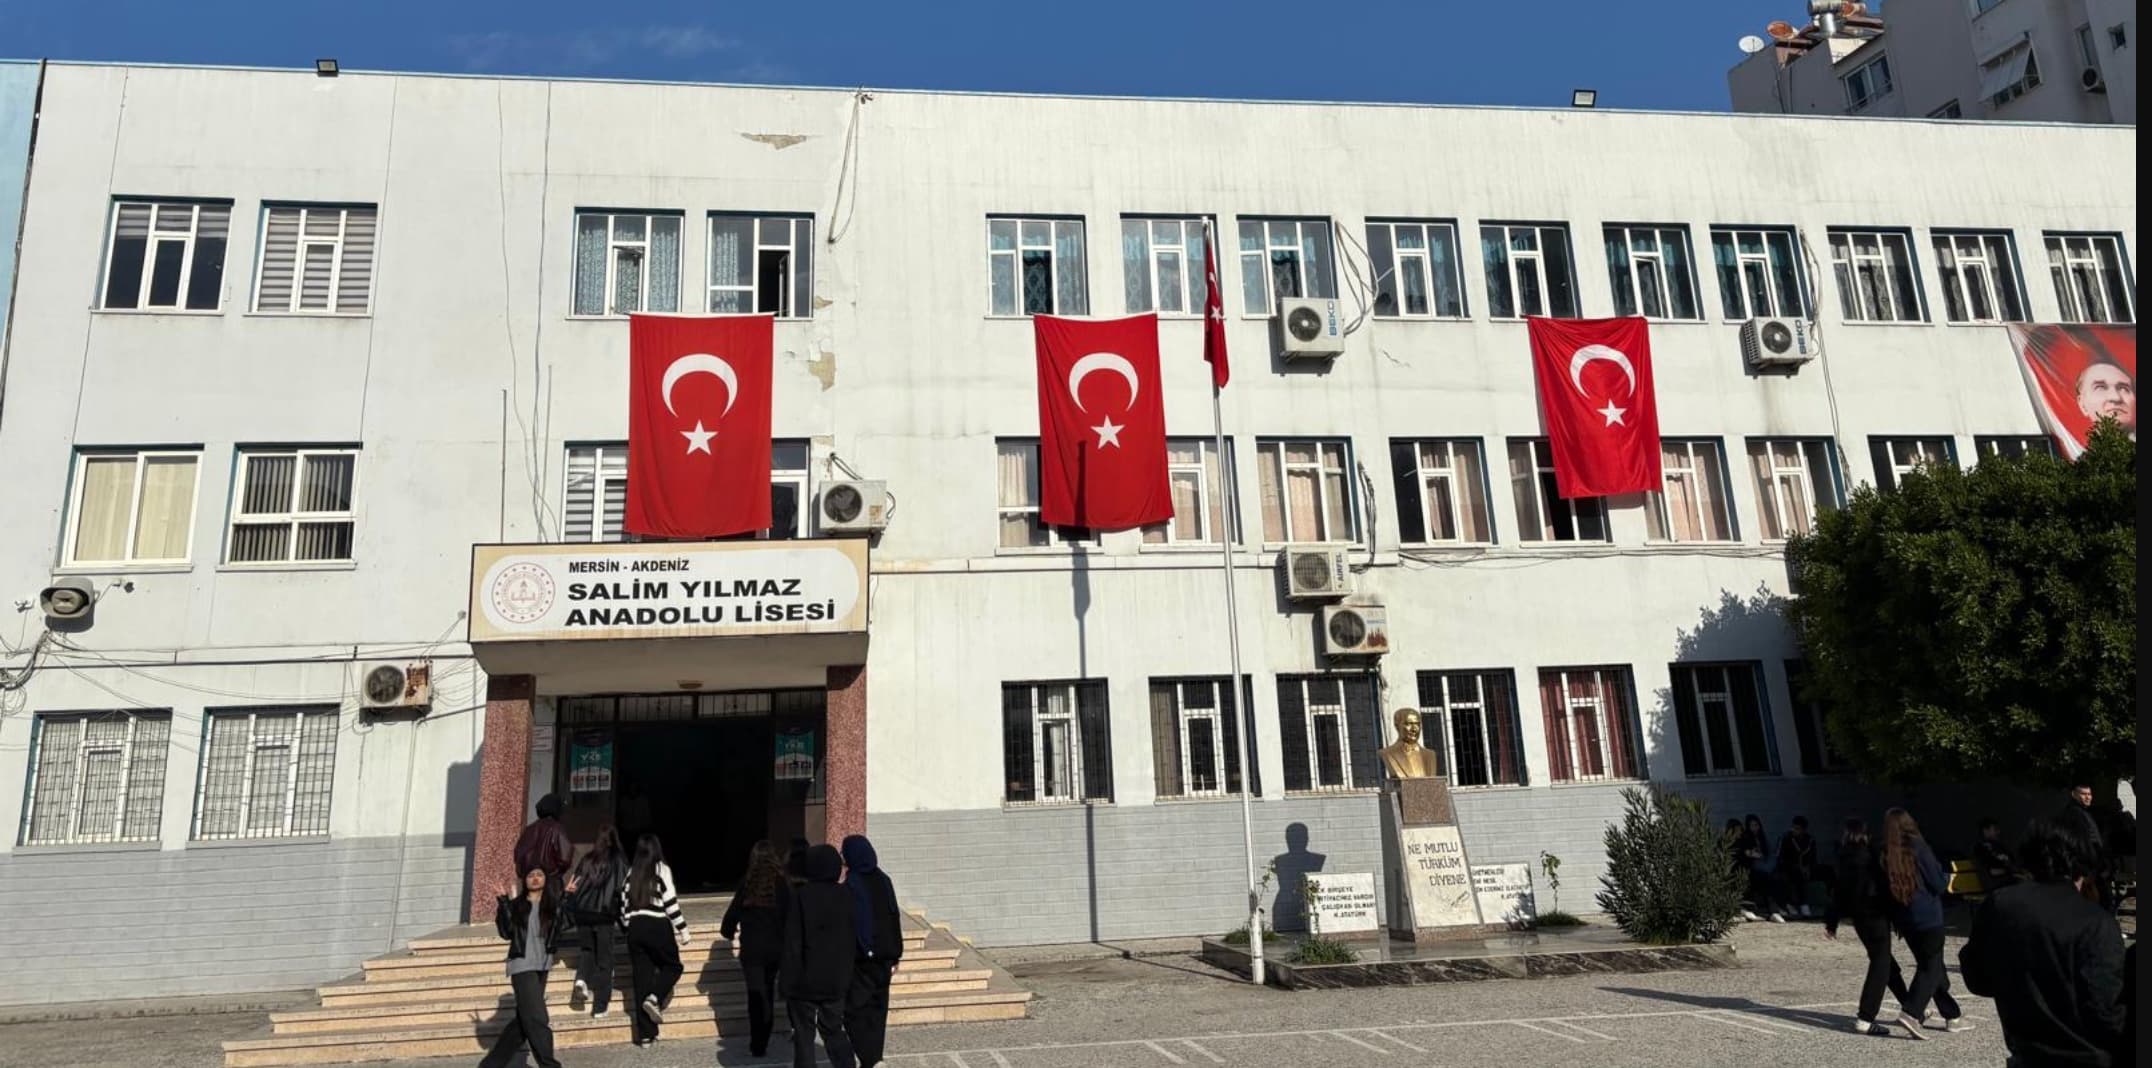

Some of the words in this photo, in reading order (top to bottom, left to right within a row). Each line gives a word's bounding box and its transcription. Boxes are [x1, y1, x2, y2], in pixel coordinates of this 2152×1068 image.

[1327, 300, 1337, 336] BEKO
[1795, 319, 1807, 355] BEKO
[569, 559, 620, 573] MERSİN
[631, 559, 690, 572] AKDENİZ
[568, 579, 668, 601] SALİM
[681, 579, 801, 597] YILMAZ
[565, 605, 722, 626] ANADOLU
[736, 599, 834, 622] LİSESİ
[1407, 843, 1422, 855] NE
[1424, 842, 1458, 854] MUTLU
[1418, 856, 1461, 869] TÜRKÜM
[1429, 872, 1467, 887] DİYENE
